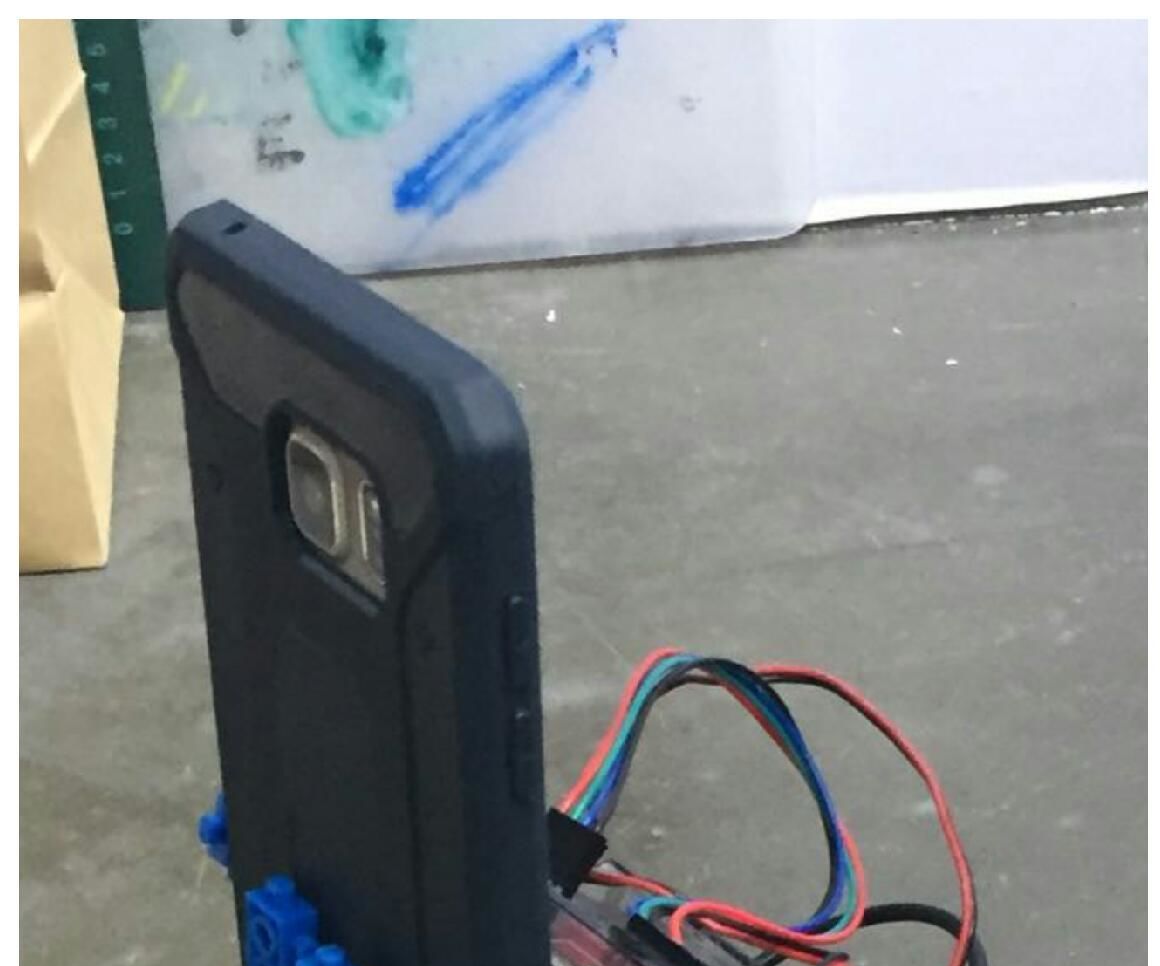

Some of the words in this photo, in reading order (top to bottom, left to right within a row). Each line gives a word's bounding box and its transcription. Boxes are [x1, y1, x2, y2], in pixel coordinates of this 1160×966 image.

[91, 81, 110, 94] 4
[103, 152, 123, 165] 2
[114, 221, 134, 235] 0
